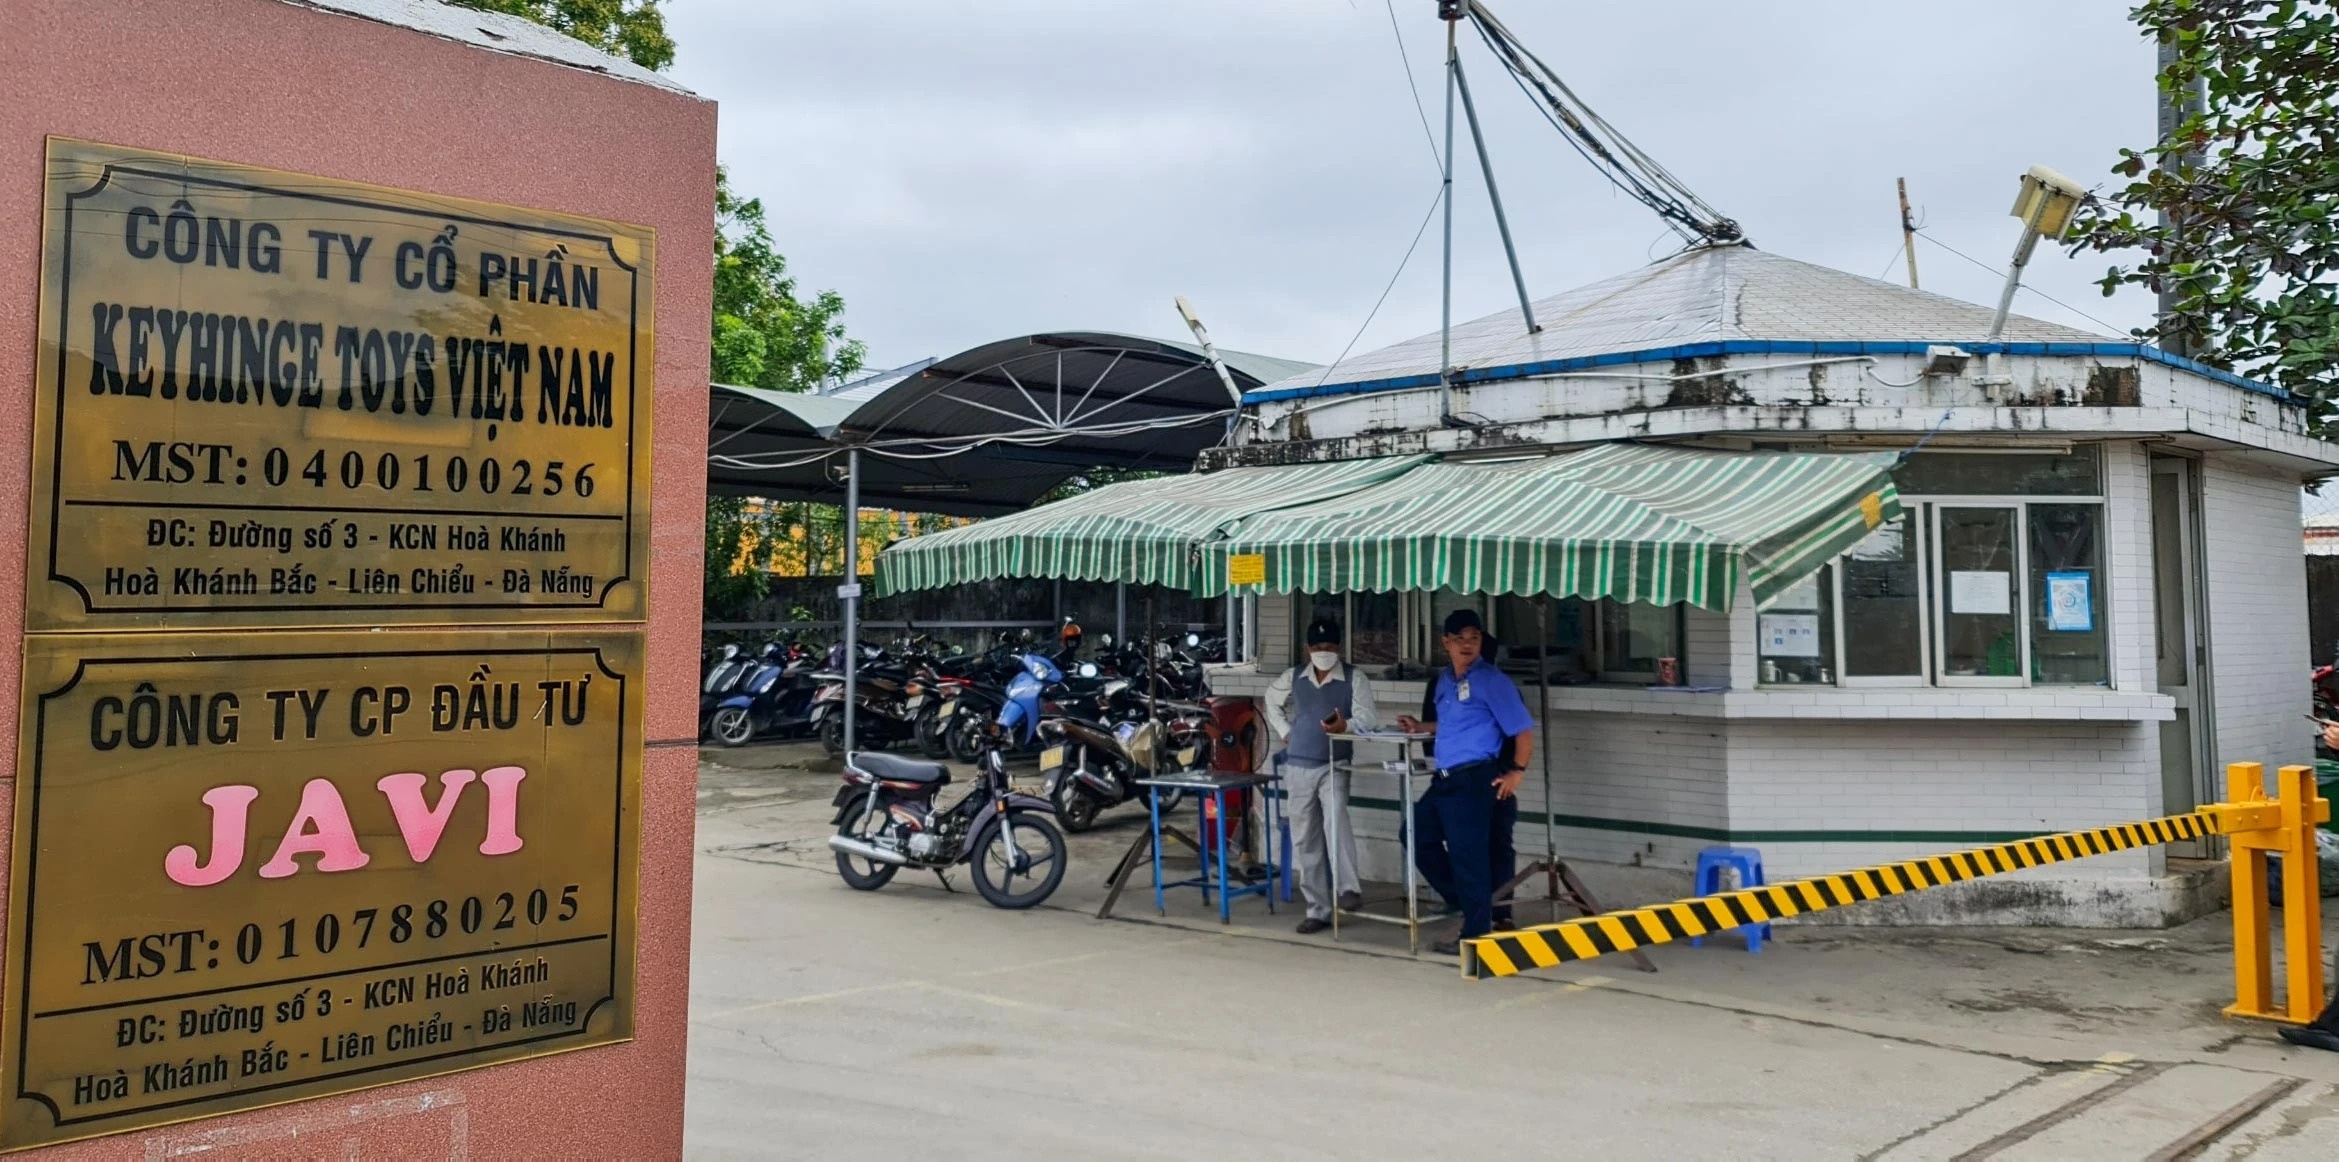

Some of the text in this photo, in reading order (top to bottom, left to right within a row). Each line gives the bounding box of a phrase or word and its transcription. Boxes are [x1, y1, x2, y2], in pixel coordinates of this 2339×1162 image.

[126, 199, 599, 310] CÔNG TY CỔ PHẦN
[89, 303, 614, 441] KEYHINGE TOYS VIỆT NAM
[112, 440, 248, 486] MST:
[147, 519, 195, 547] ĐC:
[209, 519, 292, 553] Đường
[304, 518, 338, 548] số
[344, 523, 358, 549] 3
[389, 523, 437, 550] KCN
[448, 525, 489, 550] Hoà
[501, 526, 565, 551] Khánh
[105, 567, 159, 595] Hoà
[174, 567, 257, 595] Khánh
[270, 563, 316, 595] Bắc
[349, 568, 400, 594] Liên
[411, 563, 475, 593] Chiểu
[502, 569, 530, 593] Đà
[541, 565, 593, 598] Nẵng
[90, 665, 592, 751] CÔNG TY CP ĐẦU TƯ
[165, 766, 527, 887] JAVI
[80, 929, 220, 985] MST:
[117, 1014, 166, 1048] ĐC:
[179, 1004, 264, 1038] Đường
[276, 987, 311, 1023] số
[317, 989, 332, 1016] 3
[364, 976, 414, 1010] KCN
[425, 966, 469, 1000] Hoà
[481, 957, 549, 991] Khánh
[74, 1069, 129, 1105] Hoà
[143, 1054, 228, 1094] Khánh
[241, 1040, 288, 1077] Bắc
[321, 1031, 374, 1063] Liên
[386, 1011, 453, 1051] Chiểu
[482, 1004, 511, 1035] Đà
[522, 993, 576, 1028] Nẵng
